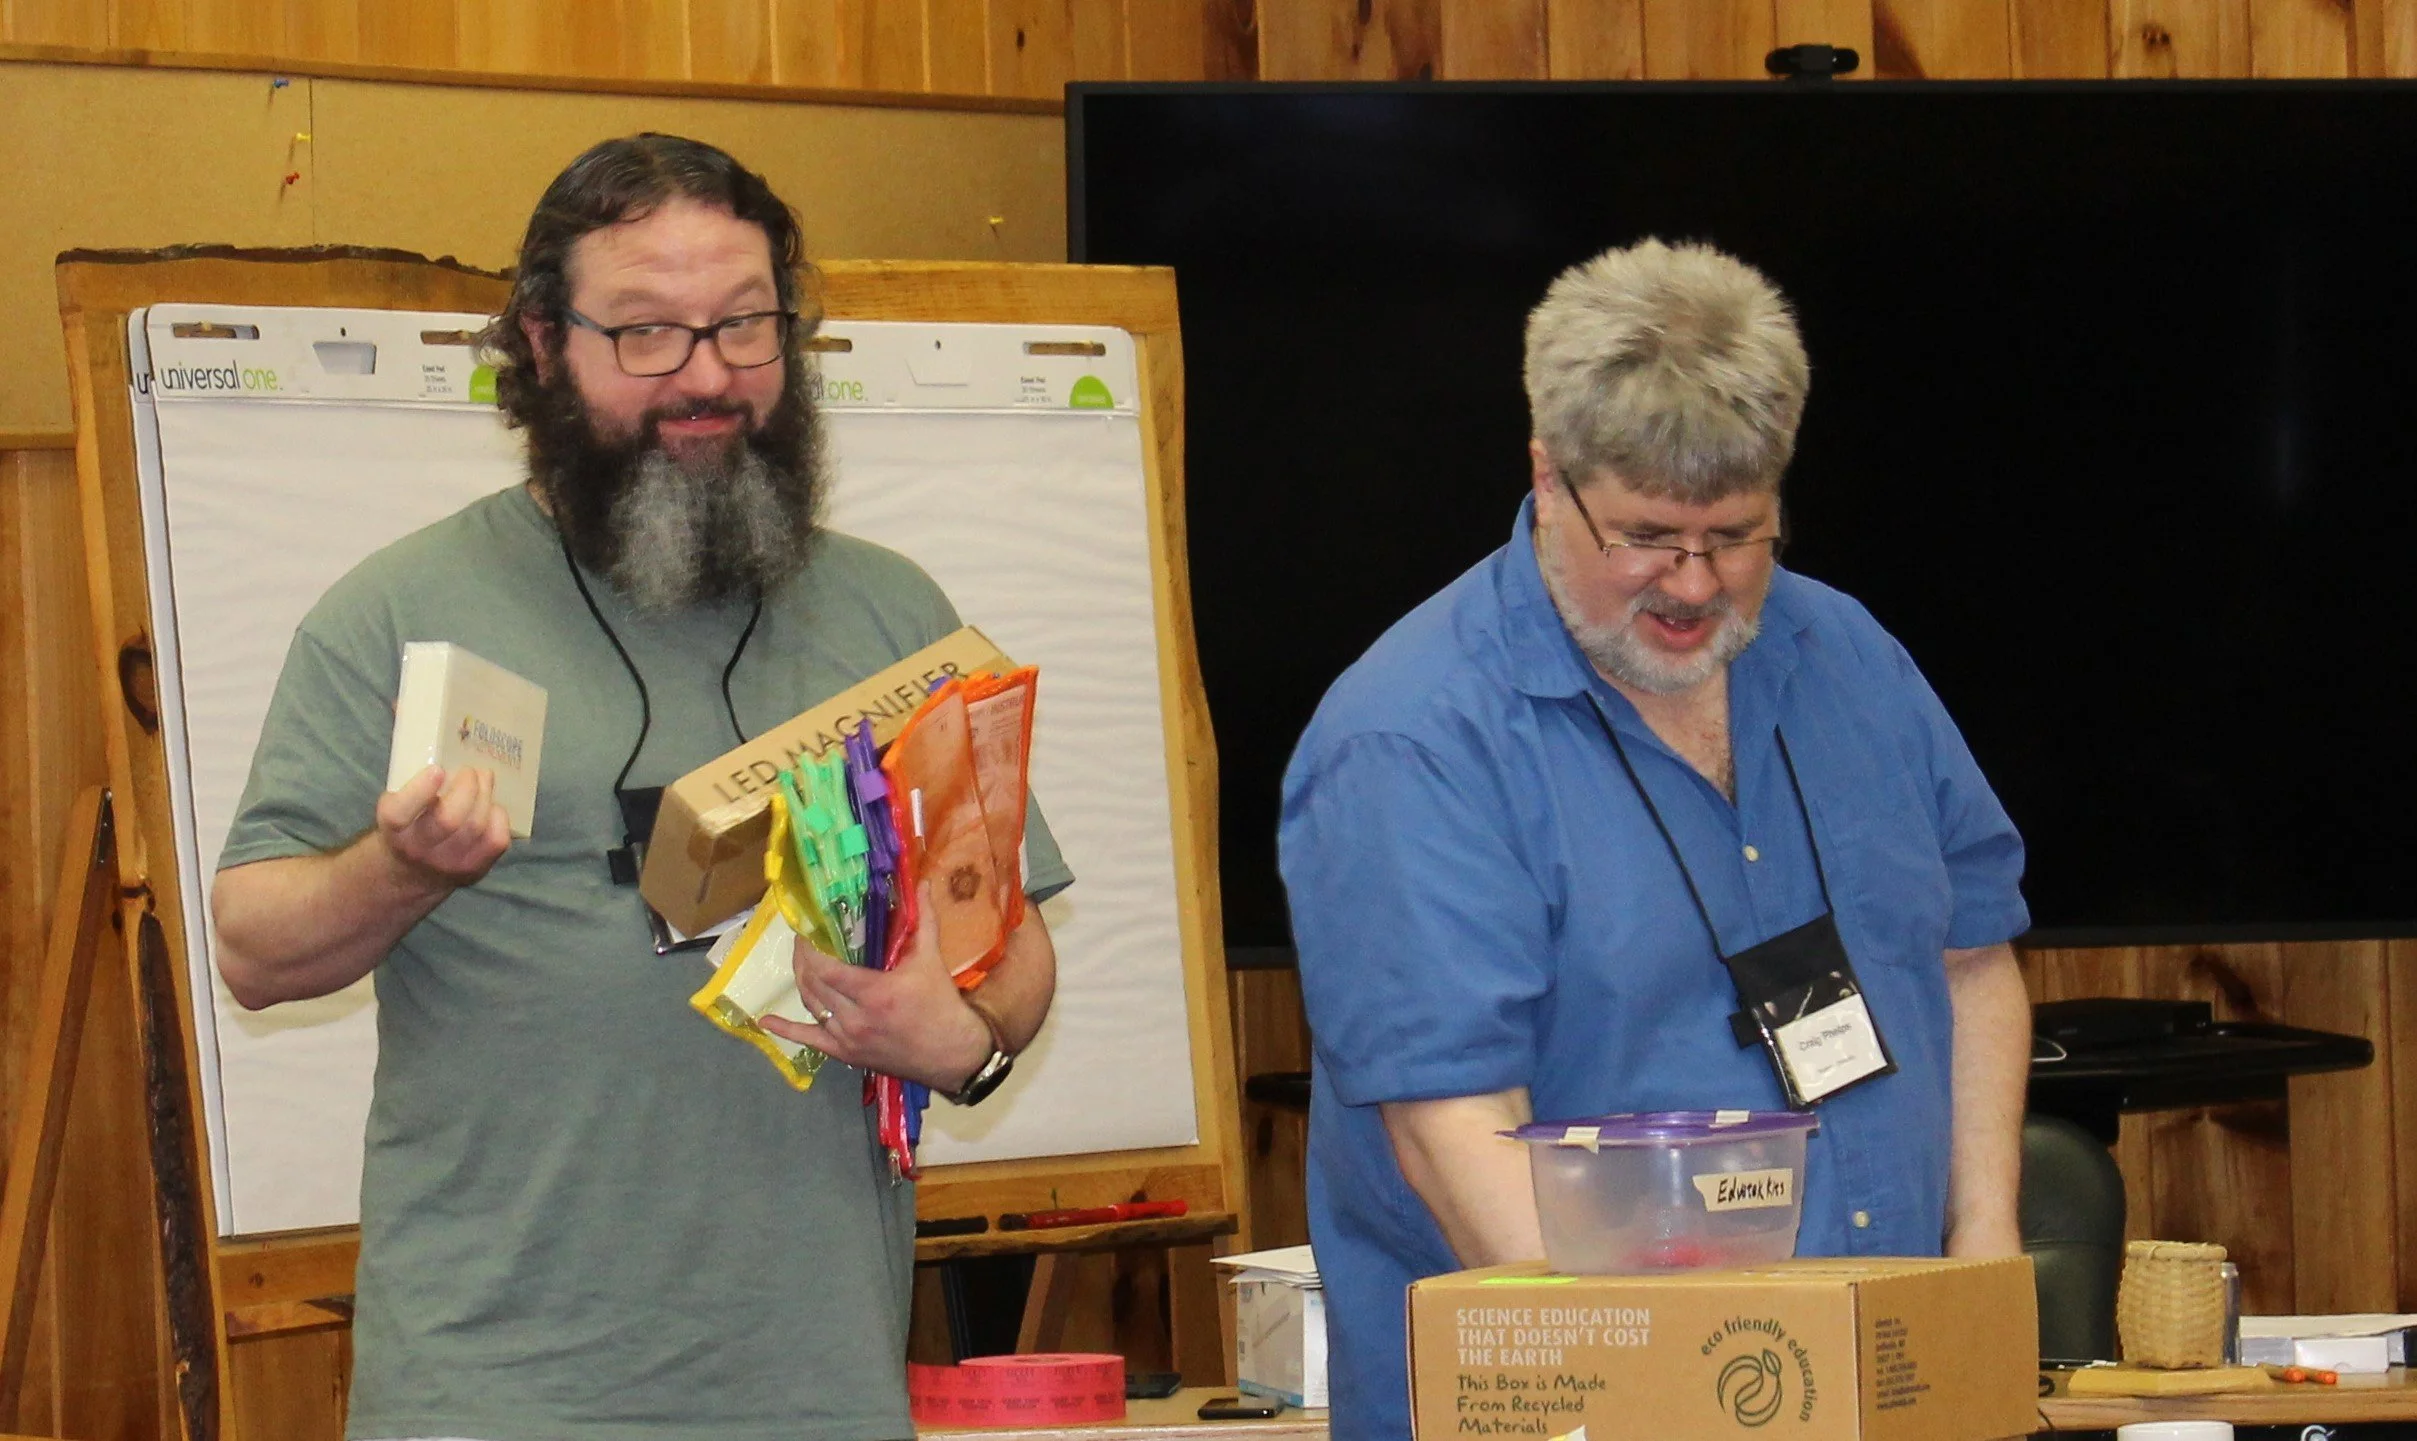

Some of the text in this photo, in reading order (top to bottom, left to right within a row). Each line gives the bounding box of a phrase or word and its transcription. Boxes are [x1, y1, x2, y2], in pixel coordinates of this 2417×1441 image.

[160, 360, 241, 390] universal
[713, 660, 969, 804] LED MAGNIFIER
[1456, 1307, 1650, 1326] SCIENCE EDUCATION
[1457, 1327, 1650, 1346] THAT DOESN'T COST
[1457, 1348, 1564, 1366] THE EARTH
[1701, 1316, 1817, 1422] eco friendly education
[1457, 1373, 1606, 1392] This Box is Made
[1456, 1395, 1585, 1416] From Recycled
[1458, 1417, 1548, 1435] Materials
